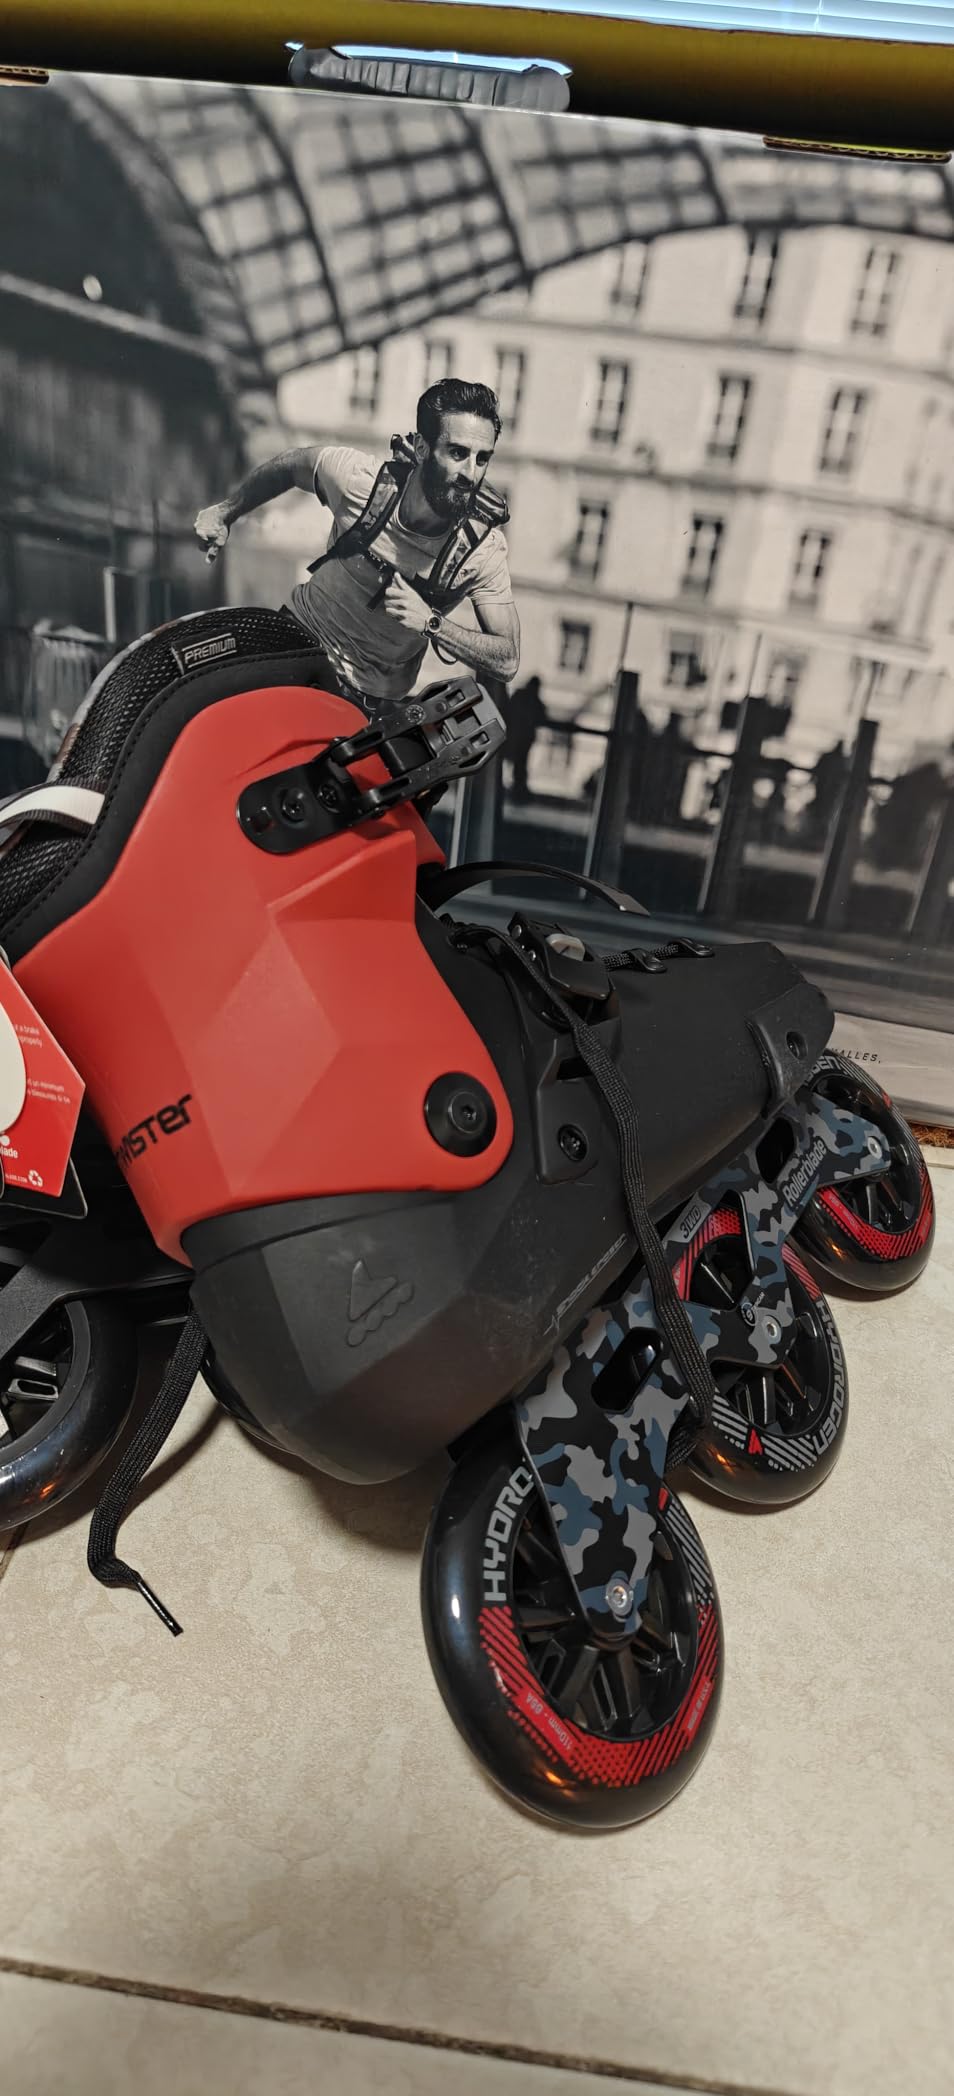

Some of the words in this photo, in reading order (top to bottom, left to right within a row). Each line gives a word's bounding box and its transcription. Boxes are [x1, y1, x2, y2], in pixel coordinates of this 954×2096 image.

[184, 637, 237, 664] PREMIUM
[782, 1139, 827, 1207] Rollerblade
[680, 1205, 702, 1239] 3WD
[812, 1300, 845, 1455] HYDROGEN
